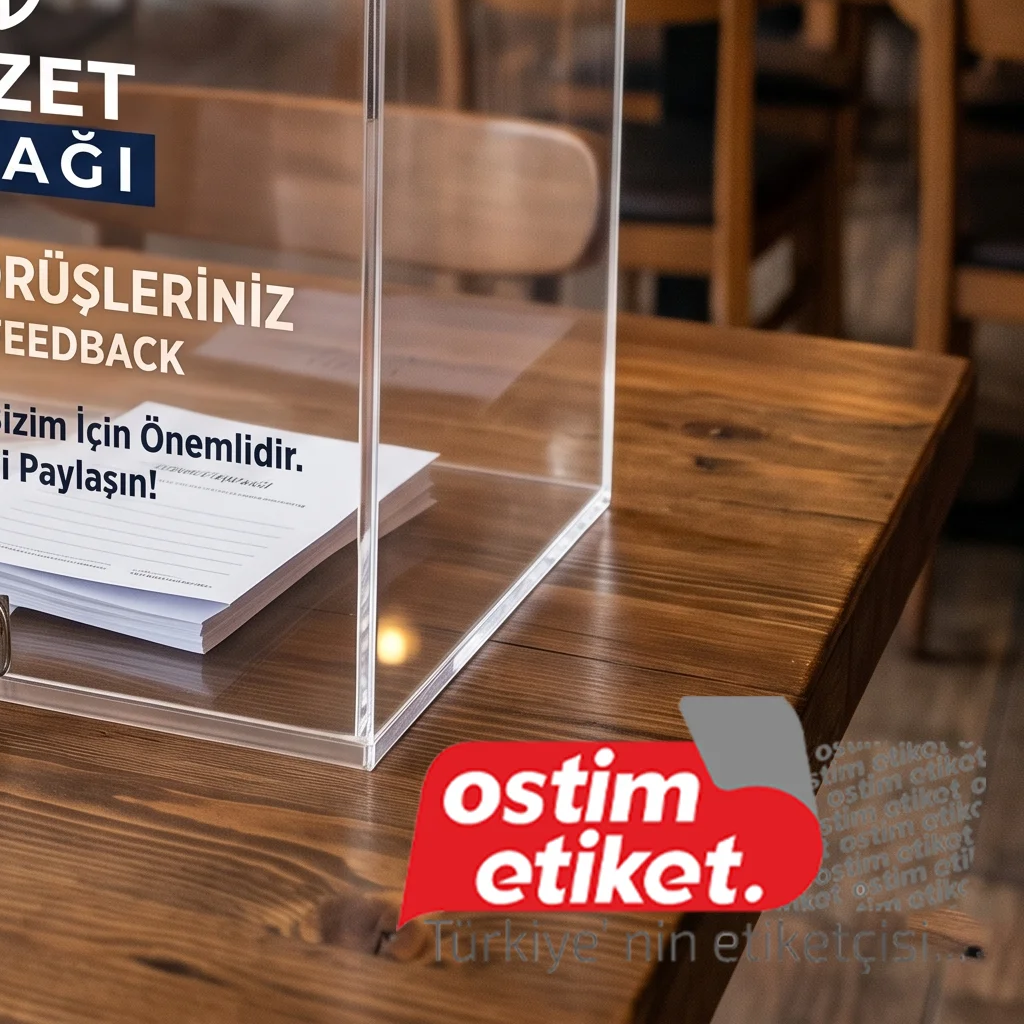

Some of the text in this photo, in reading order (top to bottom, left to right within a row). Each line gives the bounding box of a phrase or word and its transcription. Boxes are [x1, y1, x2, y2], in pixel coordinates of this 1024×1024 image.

[76, 405, 131, 454] İçin
[140, 415, 304, 473] Önemlidir.
[20, 453, 157, 501] Paylaşın!
